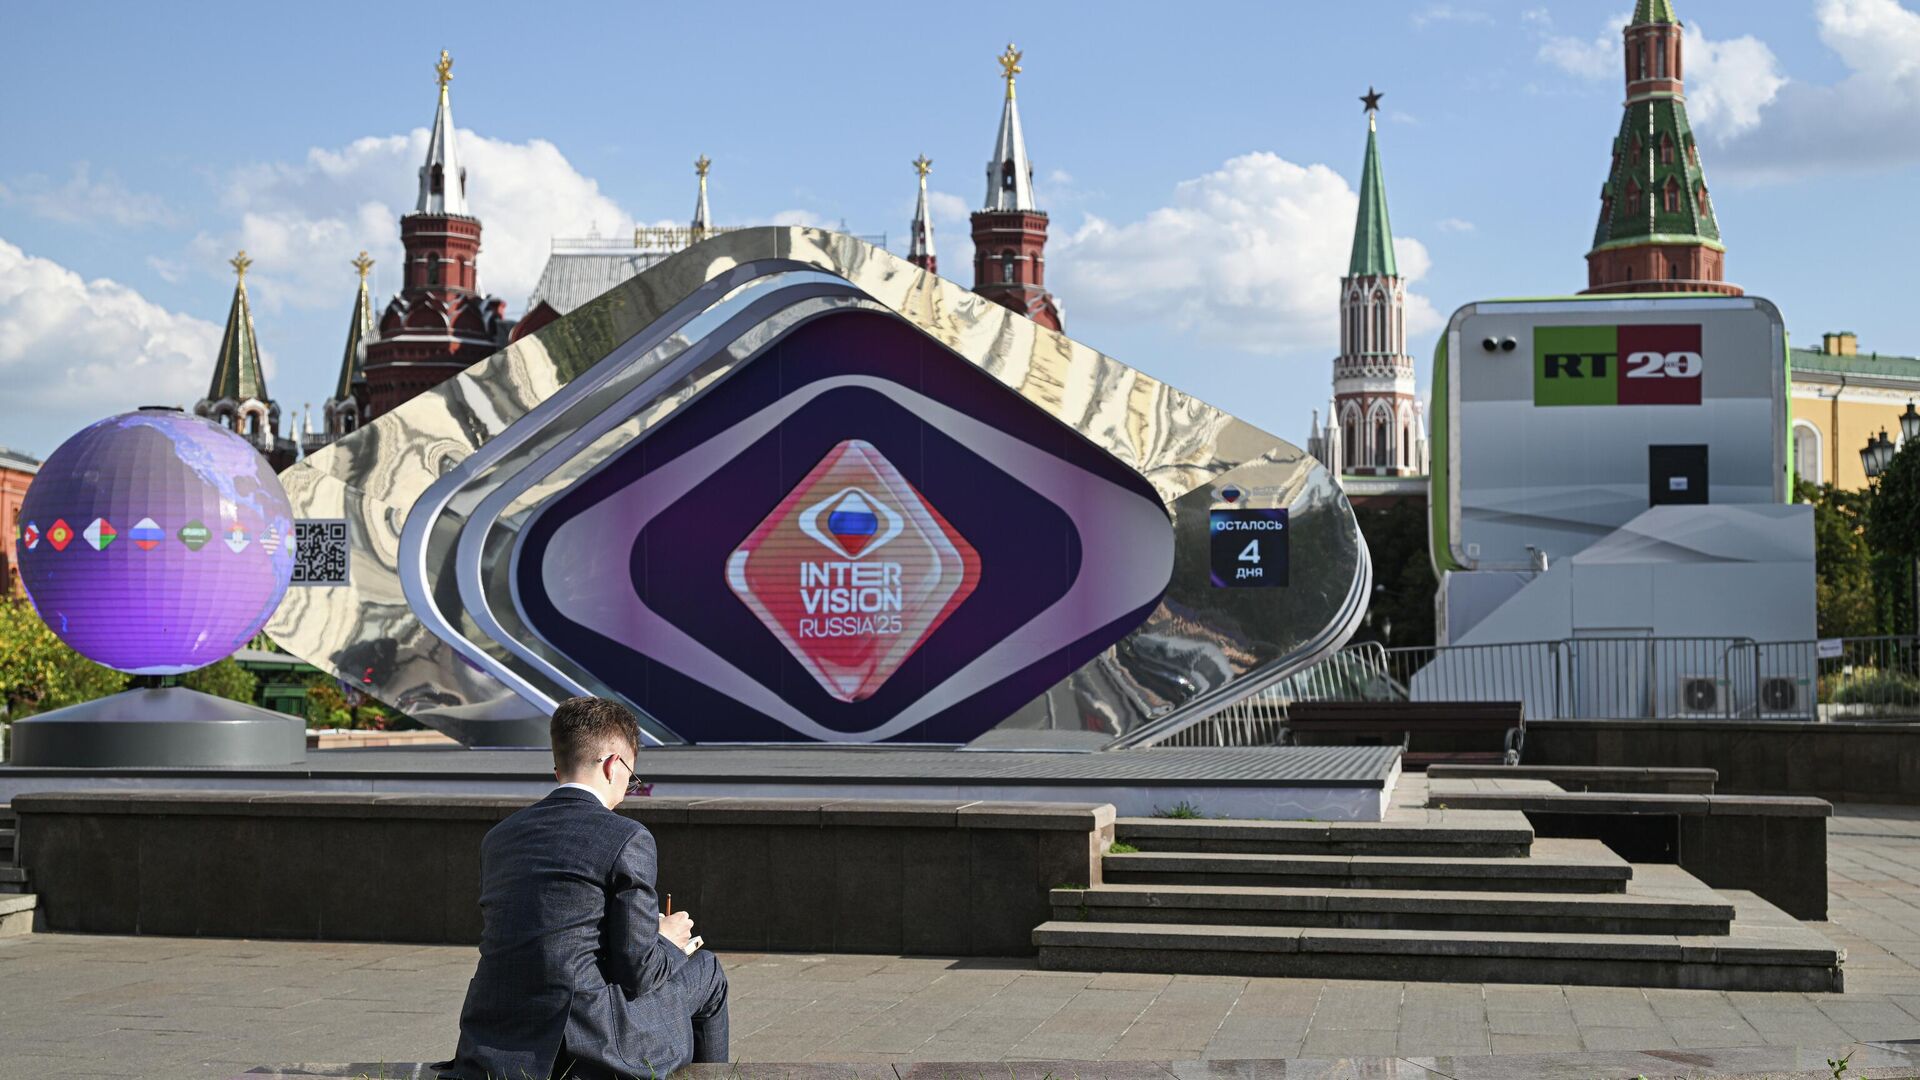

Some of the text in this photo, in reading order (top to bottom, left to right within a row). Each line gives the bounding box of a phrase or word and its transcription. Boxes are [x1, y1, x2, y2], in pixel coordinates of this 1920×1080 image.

[1544, 351, 1703, 378] RT 20
[1216, 520, 1283, 531] ОСТАЛОСЬ
[1238, 539, 1260, 564] 4
[800, 561, 902, 587] INTER
[1236, 567, 1263, 579] ДНЯ
[800, 588, 902, 614] VISION
